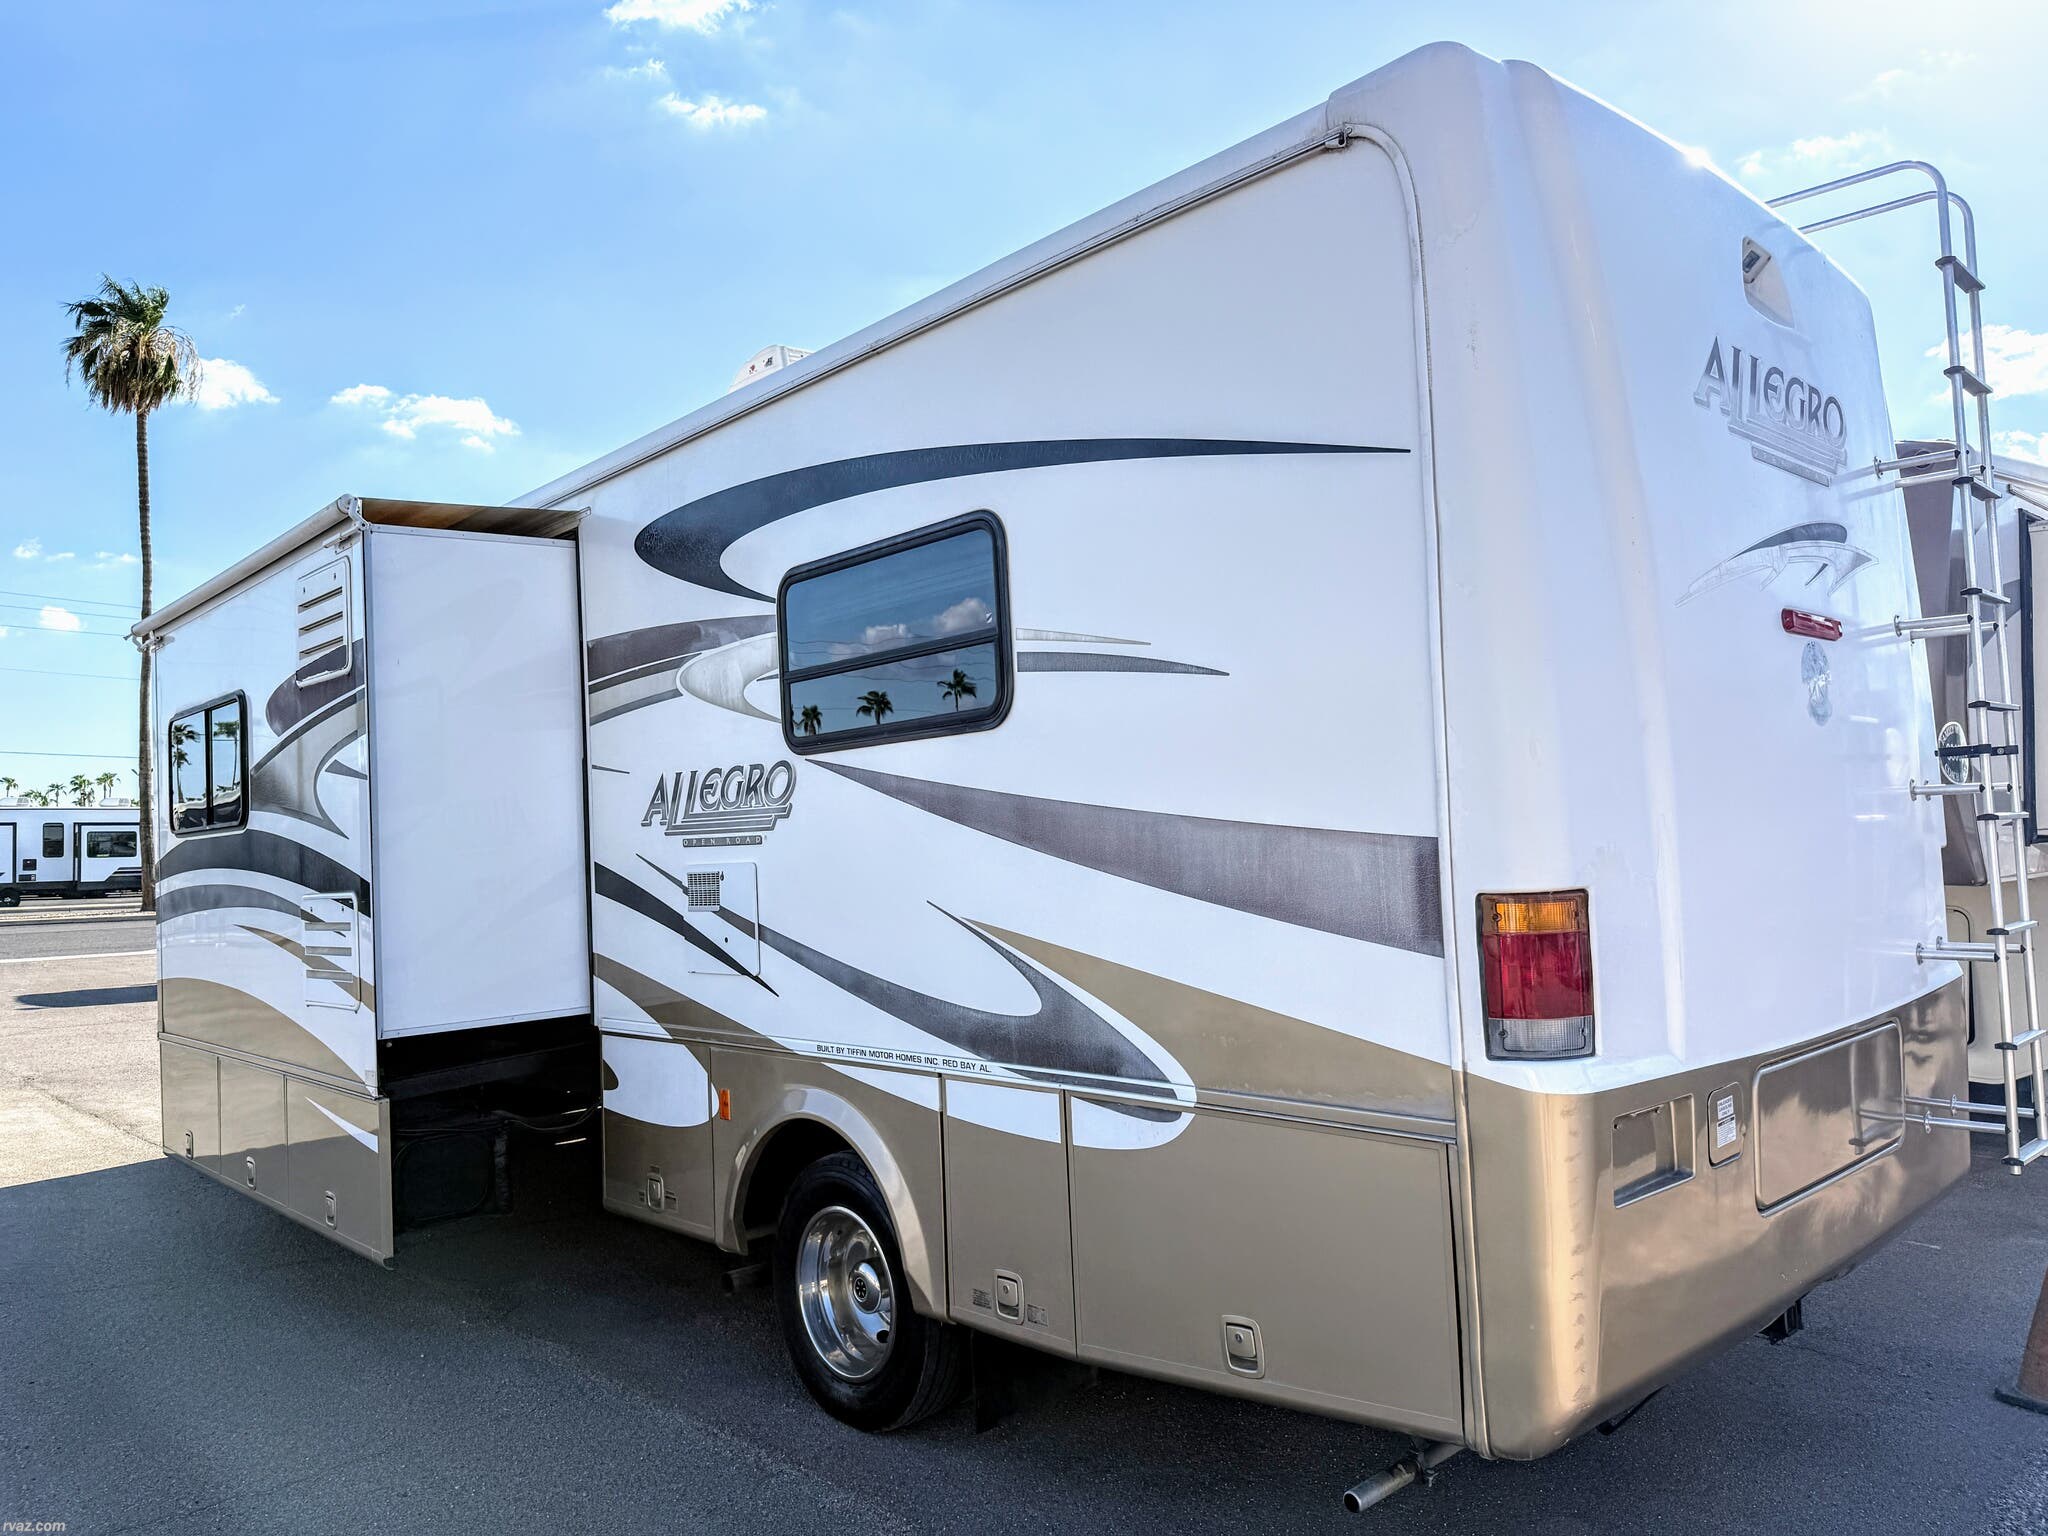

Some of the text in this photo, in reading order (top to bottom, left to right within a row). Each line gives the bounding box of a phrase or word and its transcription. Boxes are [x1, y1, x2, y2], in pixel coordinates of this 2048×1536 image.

[1693, 335, 1848, 475] ALLEGRO
[641, 759, 797, 836] ALLEGRO
[683, 836, 761, 847] OPEN ROAD
[816, 1044, 992, 1073] BUILT BY TIFFIN MOTOR HOMES INC. RED BAY AL.
